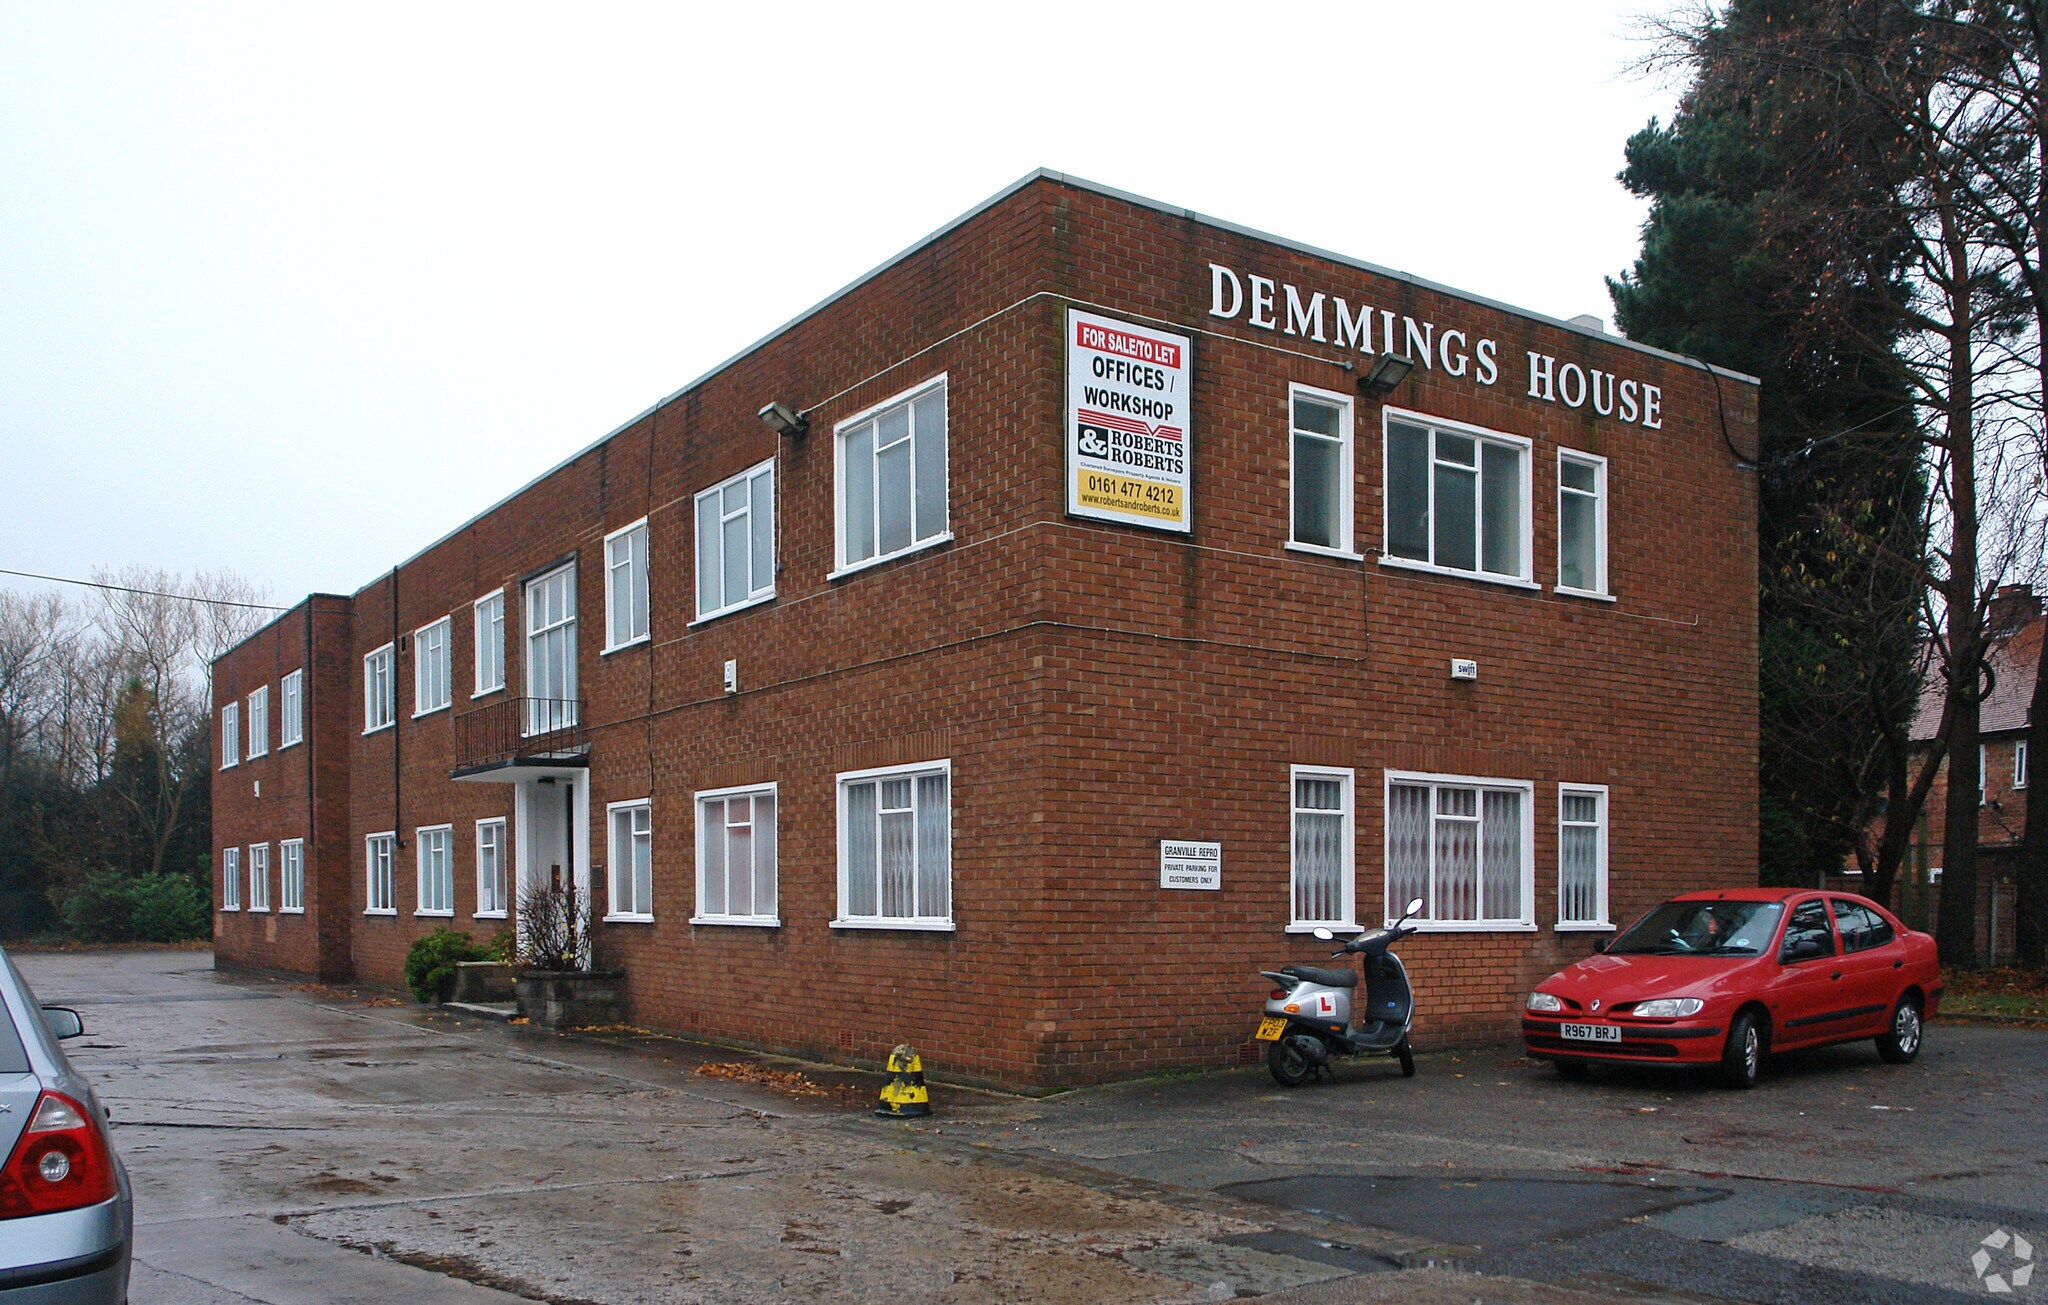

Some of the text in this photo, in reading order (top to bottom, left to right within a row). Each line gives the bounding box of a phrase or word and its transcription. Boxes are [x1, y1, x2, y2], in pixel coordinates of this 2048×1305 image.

[1083, 326, 1107, 348] FOR
[1154, 342, 1175, 364] LET
[1208, 262, 1664, 430] DEMMINGS HOUSE
[1092, 355, 1164, 391] OFFICES
[1084, 385, 1173, 421] WORKSHOP
[1079, 428, 1107, 455] &
[1111, 430, 1183, 458] ROBERTS
[1080, 461, 1103, 470] Chartered
[1103, 465, 1125, 474] Surveyors
[1125, 469, 1145, 478] Property
[1111, 446, 1183, 474] ROBERTS
[1088, 475, 1174, 504] 0161 477 4212
[1081, 493, 1180, 517] www.robertsandroberts.co.uk
[1165, 846, 1217, 857] GRANVILLE REPRO
[1320, 997, 1331, 1011] L
[1565, 1025, 1617, 1040] R967 BRJ
